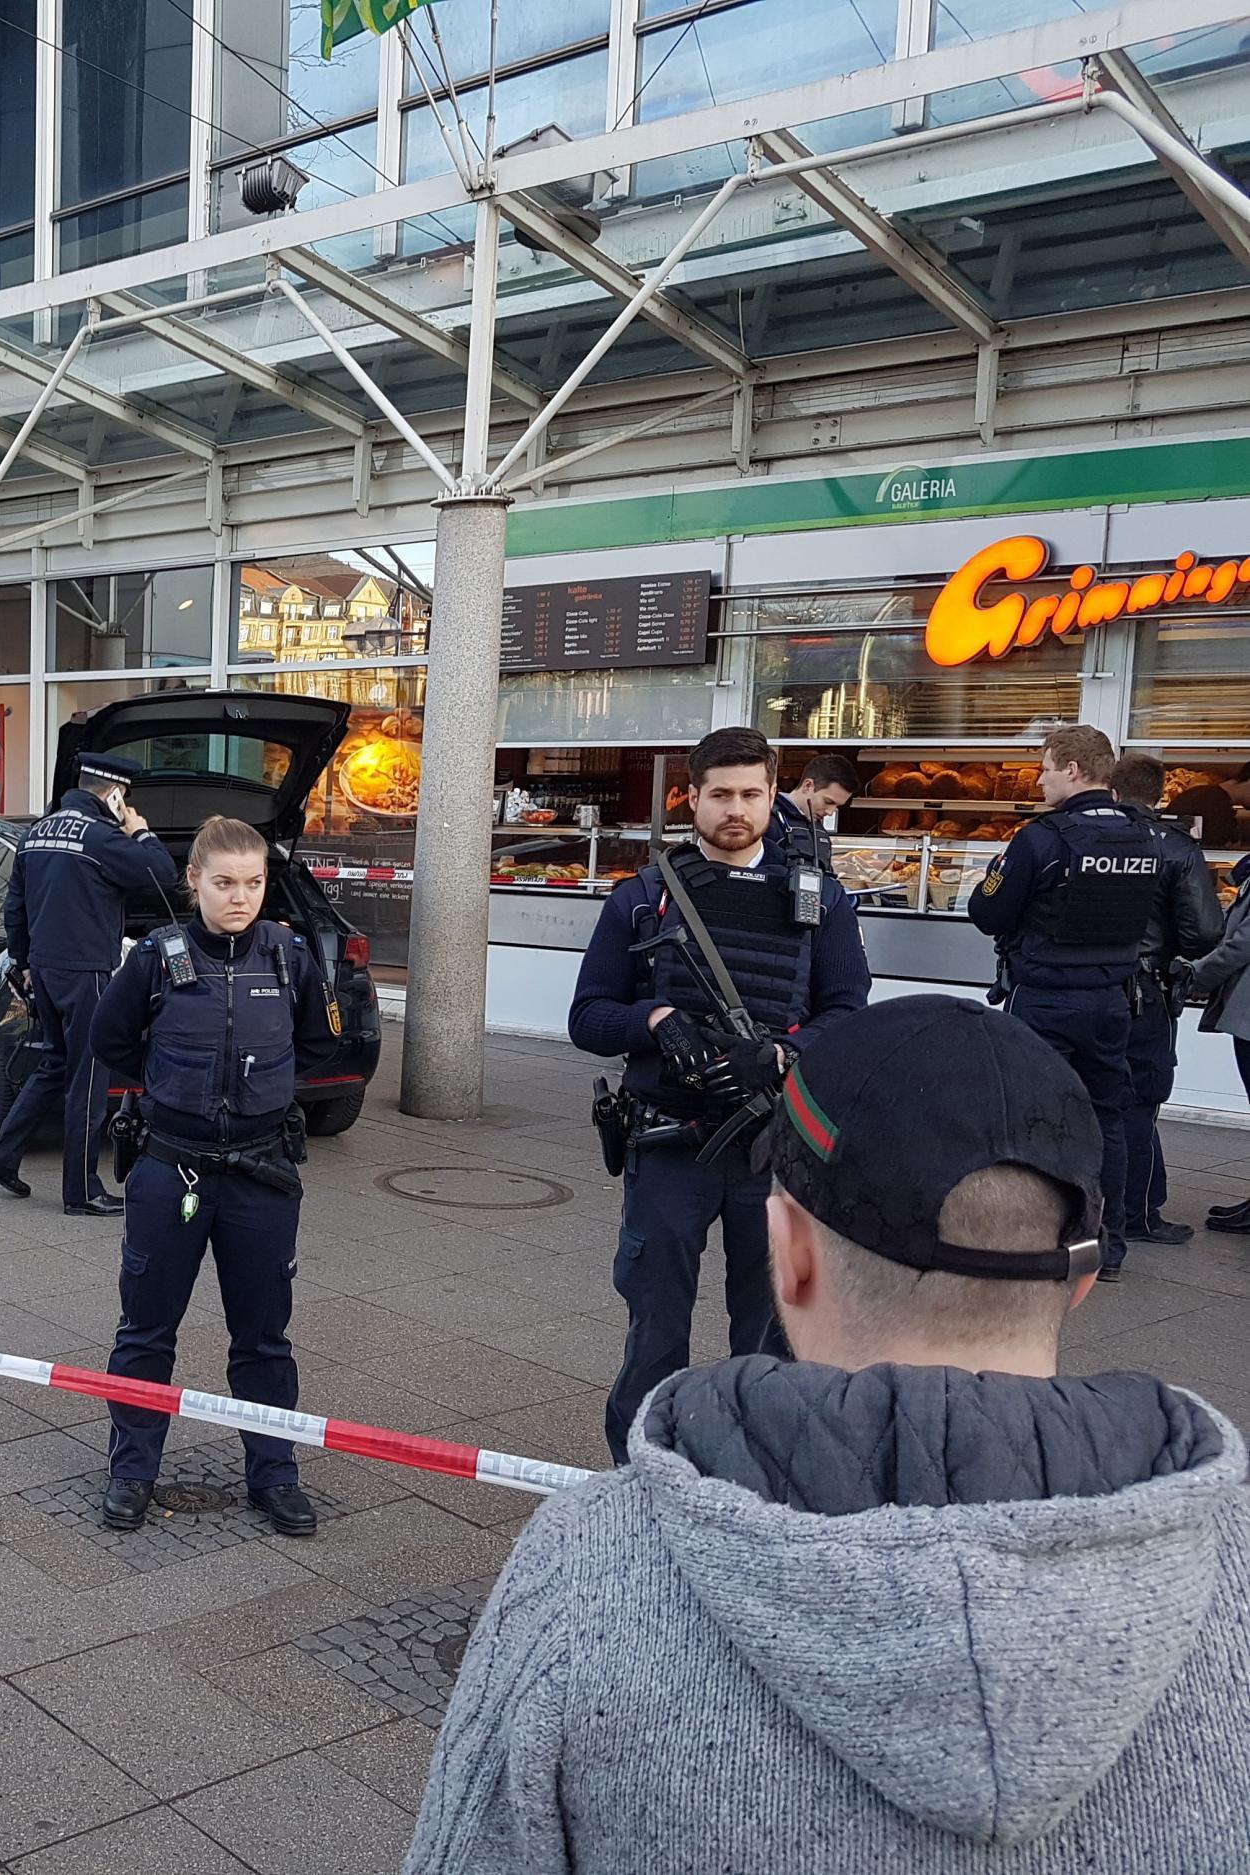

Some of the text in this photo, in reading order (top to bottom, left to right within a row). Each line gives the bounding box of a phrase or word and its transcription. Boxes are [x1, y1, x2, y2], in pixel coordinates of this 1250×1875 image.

[891, 478, 956, 502] GALERIA
[29, 819, 90, 840] POLIZEI
[1081, 856, 1158, 875] POLIZEI
[321, 881, 344, 901] Tag!
